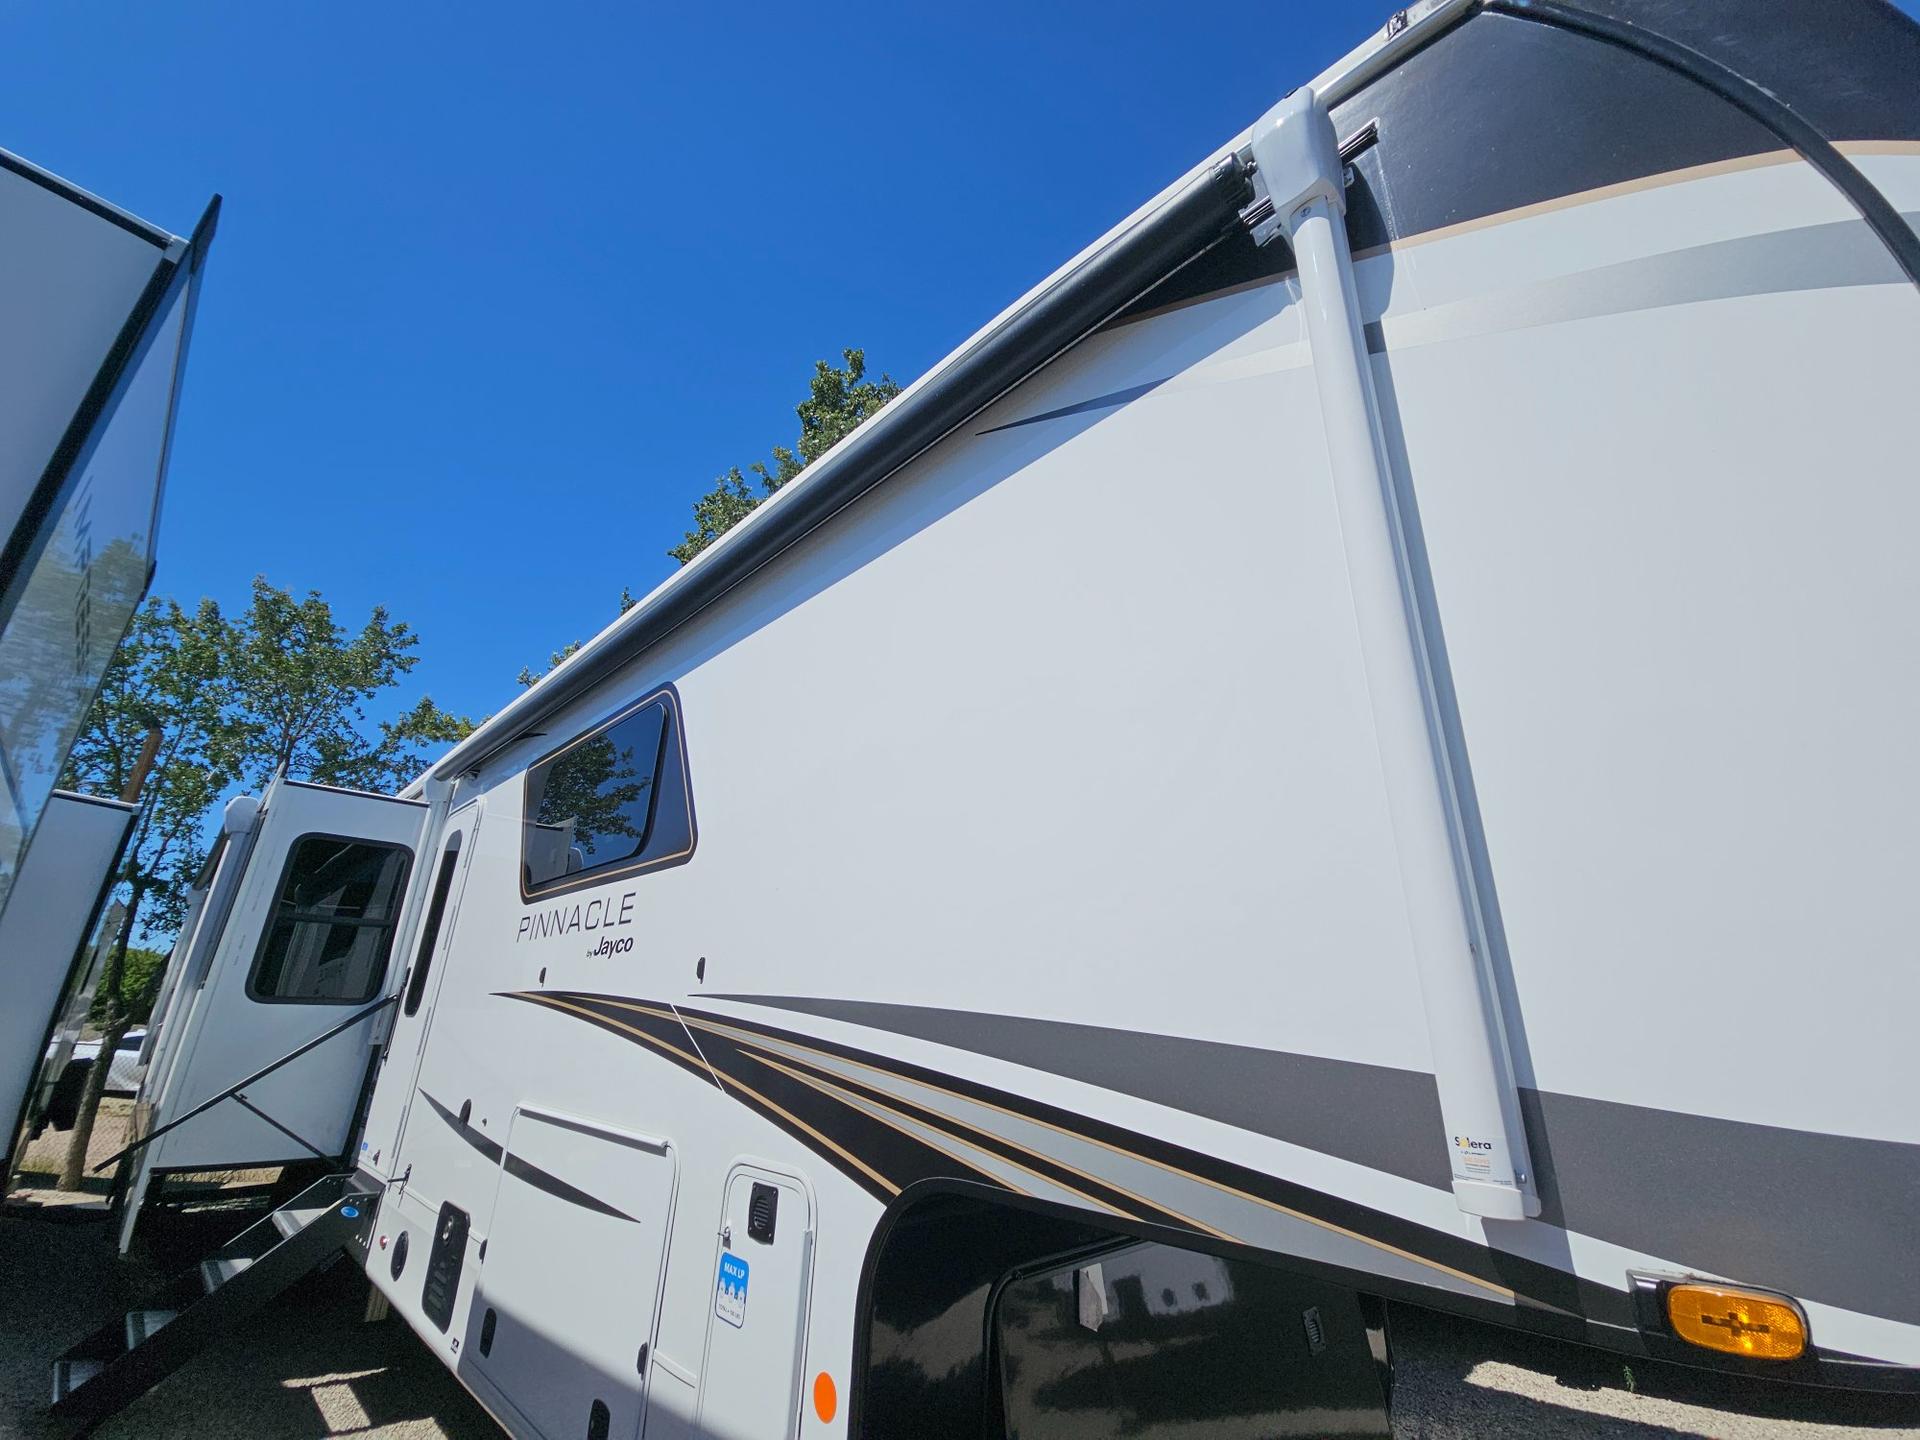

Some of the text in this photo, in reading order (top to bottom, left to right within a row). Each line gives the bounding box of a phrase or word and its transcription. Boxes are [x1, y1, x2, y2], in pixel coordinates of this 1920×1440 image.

[516, 892, 637, 943] PINNACLE
[593, 936, 634, 960] Jayco
[724, 1262, 745, 1279] MAX LP
